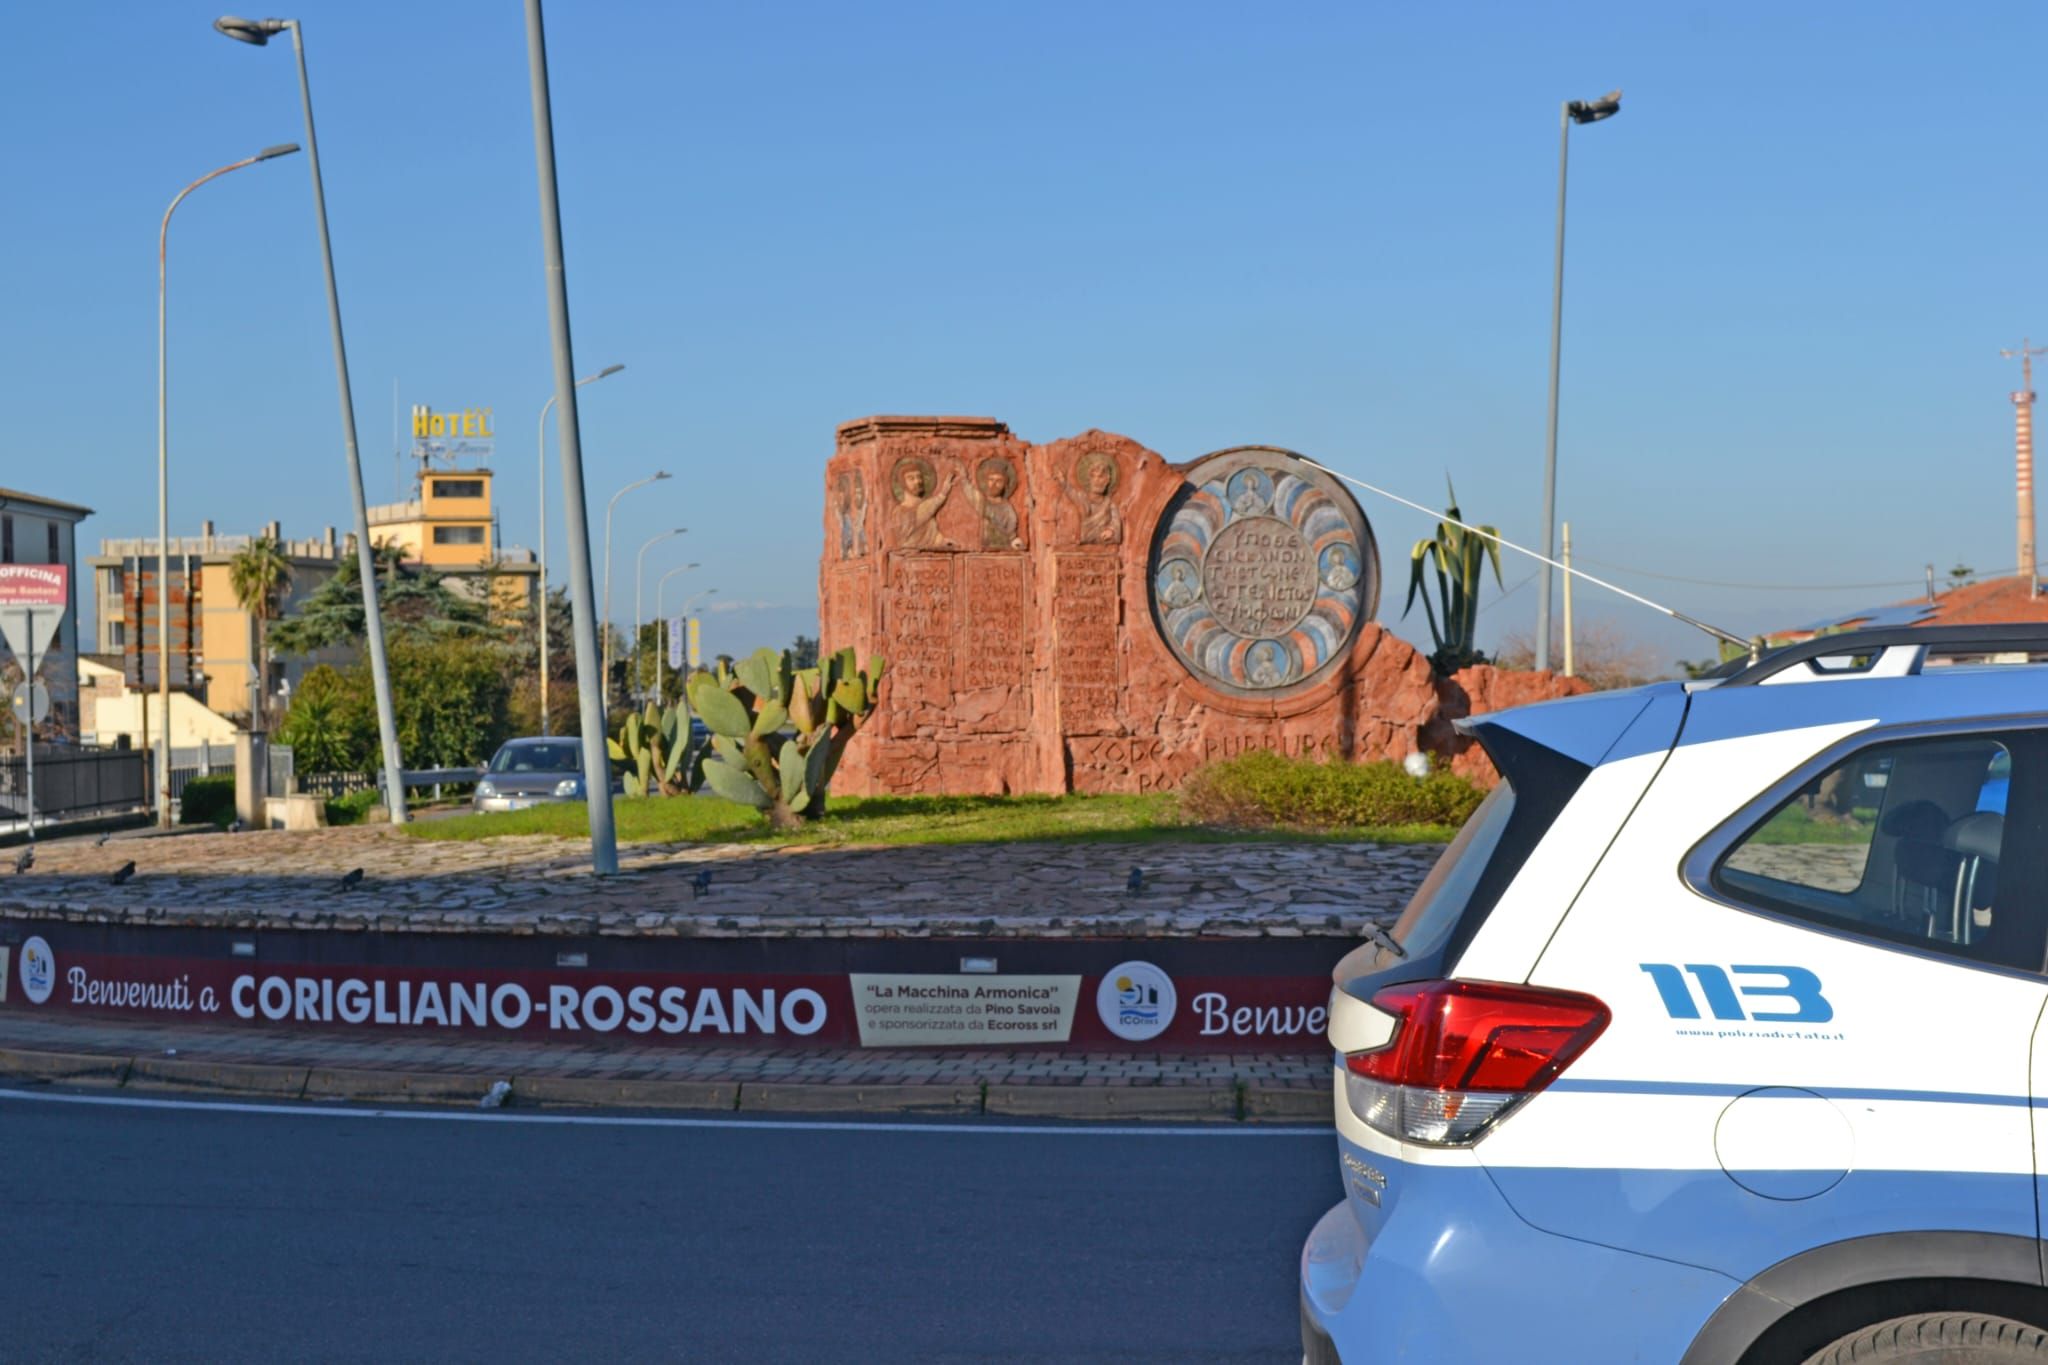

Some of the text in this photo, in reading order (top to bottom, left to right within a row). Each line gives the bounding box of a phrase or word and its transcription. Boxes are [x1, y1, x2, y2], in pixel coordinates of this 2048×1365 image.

[412, 412, 494, 438] HOTEL
[0, 567, 62, 586] OFFICINA
[67, 965, 828, 1036] Benvenuti a CORIGLIANO-ROSSANO
[897, 985, 970, 999] Macchina
[1639, 963, 1834, 1023] 113
[865, 1002, 1061, 1016] opera realizzata da Pino Savoia
[1192, 993, 1327, 1036] Benve
[868, 1018, 1058, 1033] e sponsorizzata da Ecoross srl
